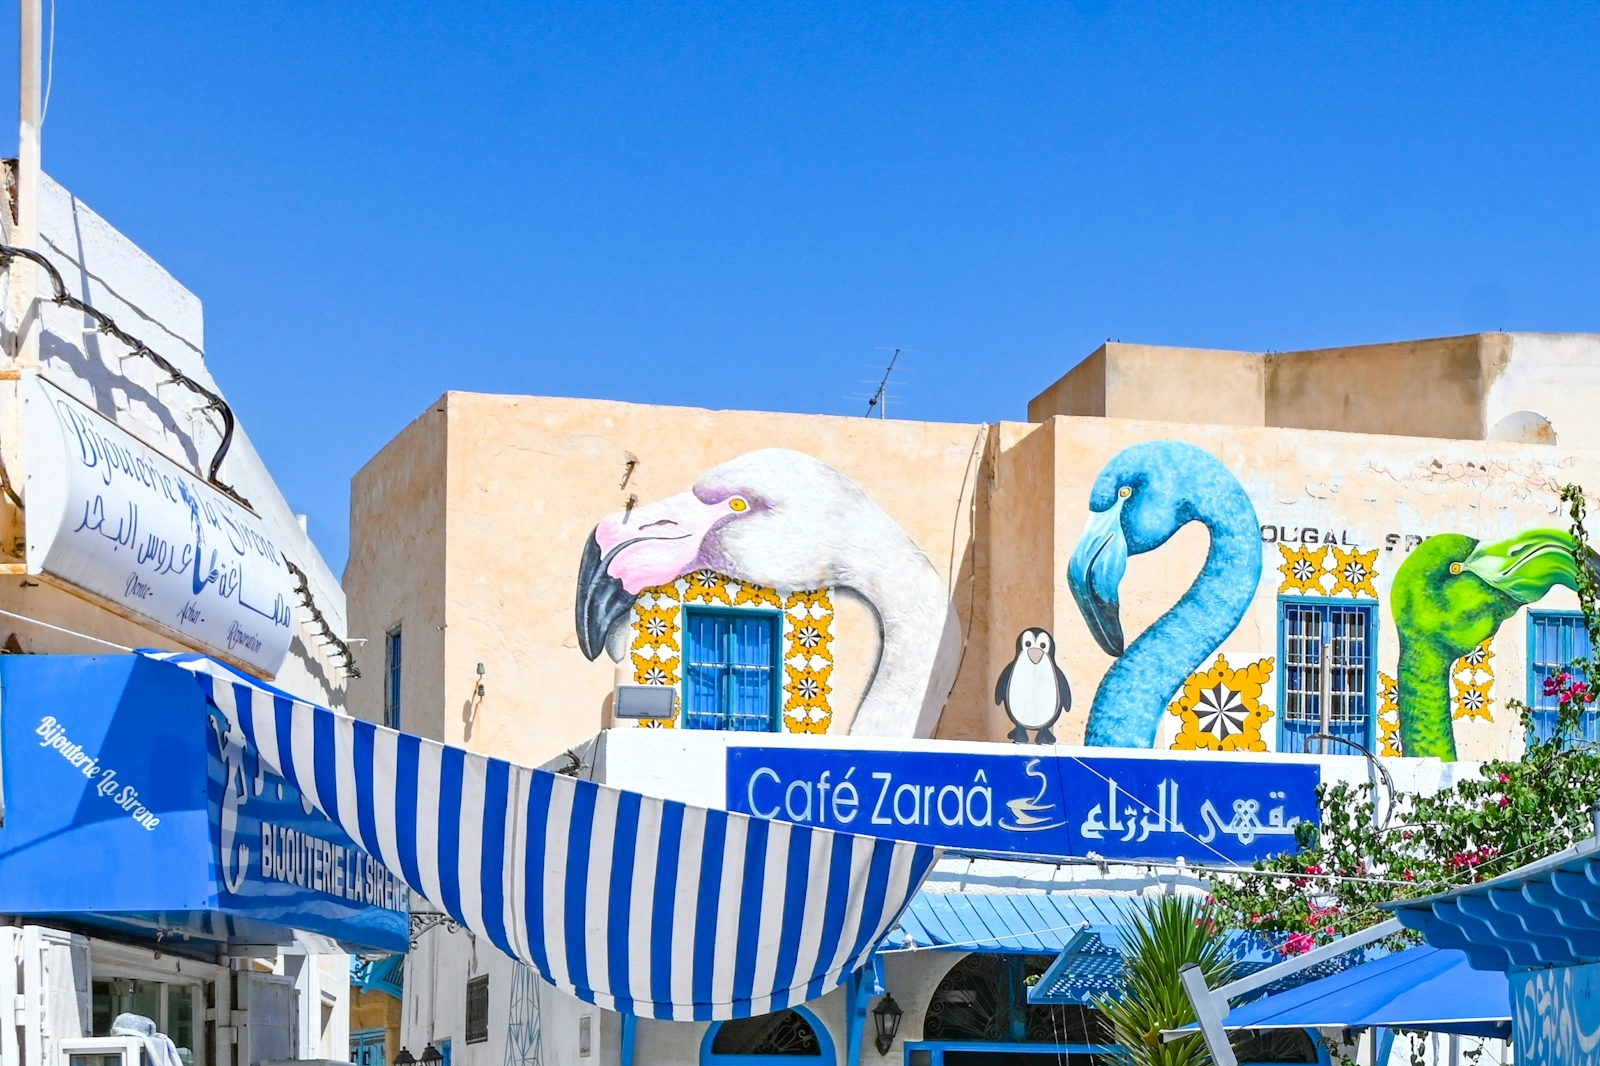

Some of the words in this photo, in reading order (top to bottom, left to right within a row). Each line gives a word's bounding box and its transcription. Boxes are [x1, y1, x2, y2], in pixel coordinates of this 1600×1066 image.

[57, 399, 177, 505] Bijouterie
[35, 715, 101, 779] Bijouterie
[96, 769, 120, 797] La
[113, 785, 161, 832] Sirene
[747, 766, 859, 825] Café
[870, 768, 993, 827] Zaraâ
[261, 821, 344, 898] BIJOUTERIE
[346, 848, 363, 903] LA
